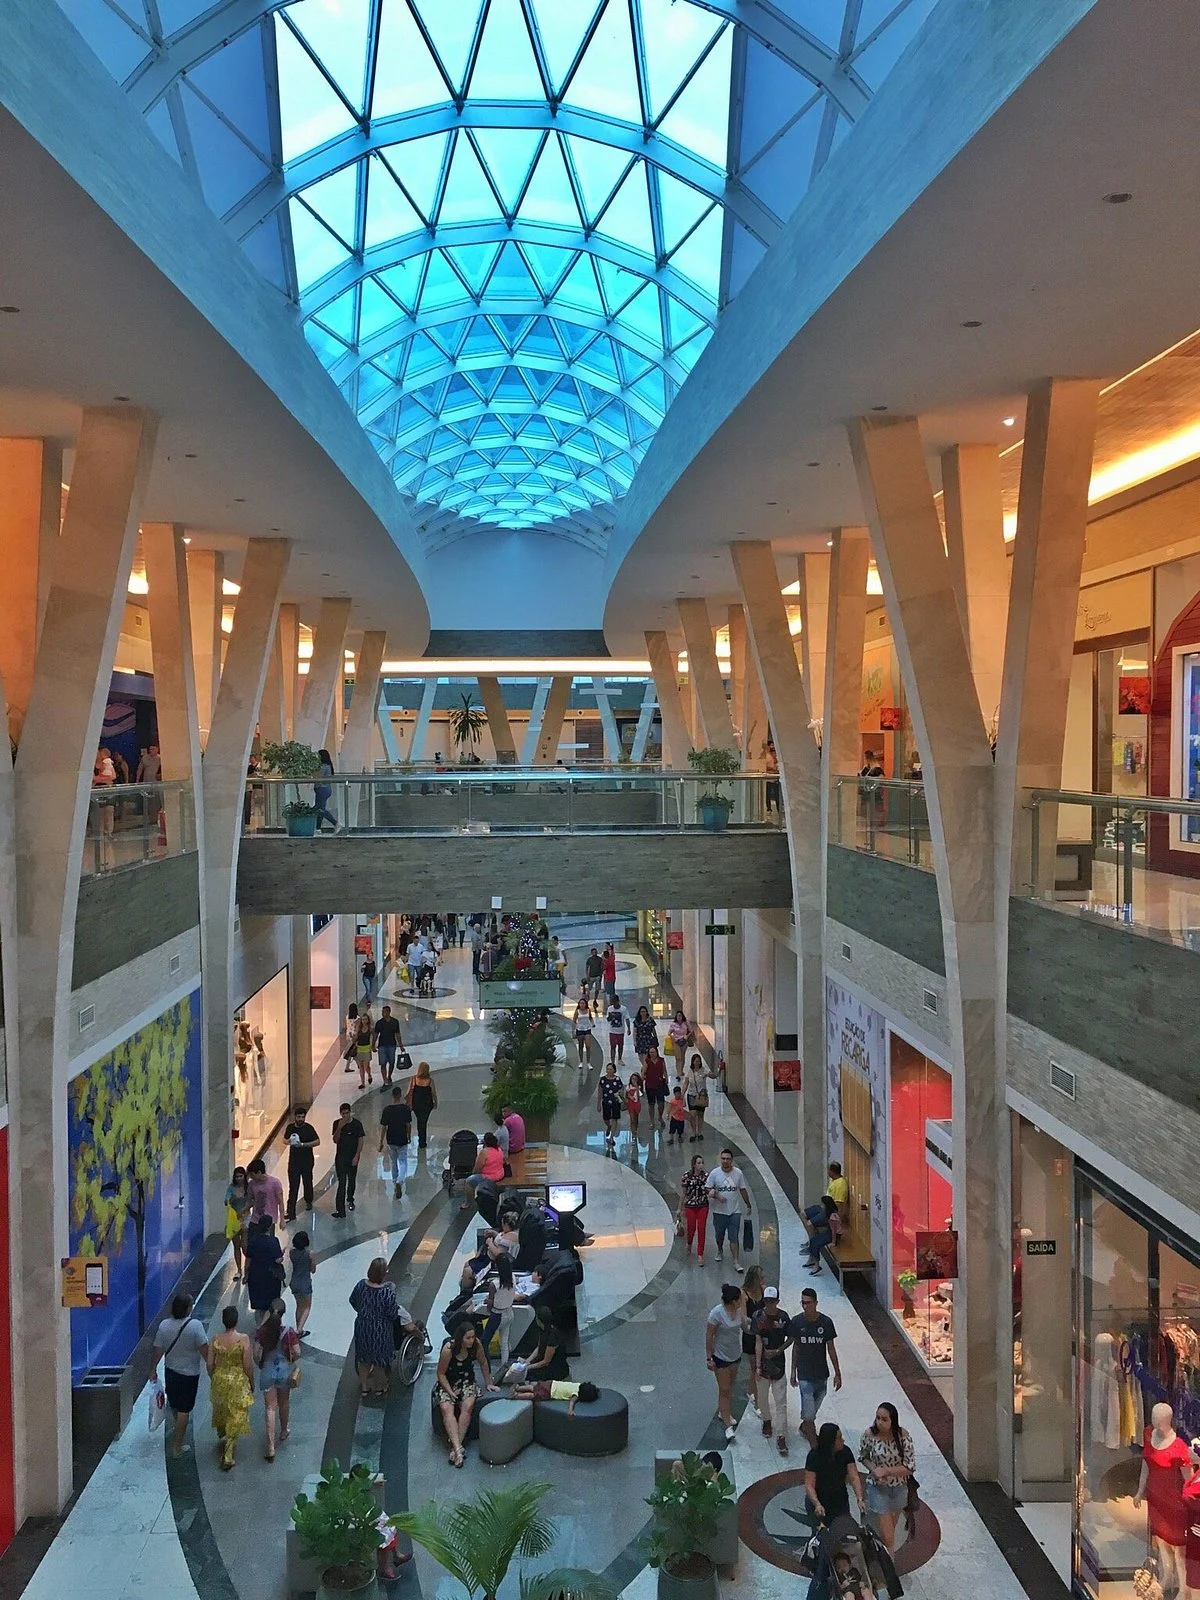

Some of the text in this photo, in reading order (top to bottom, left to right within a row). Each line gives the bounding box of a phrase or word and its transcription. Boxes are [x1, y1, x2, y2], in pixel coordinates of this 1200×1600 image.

[841, 1030, 871, 1077] RECARGA
[1028, 1243, 1055, 1252] SAÍDA
[800, 1336, 824, 1344] BMW
